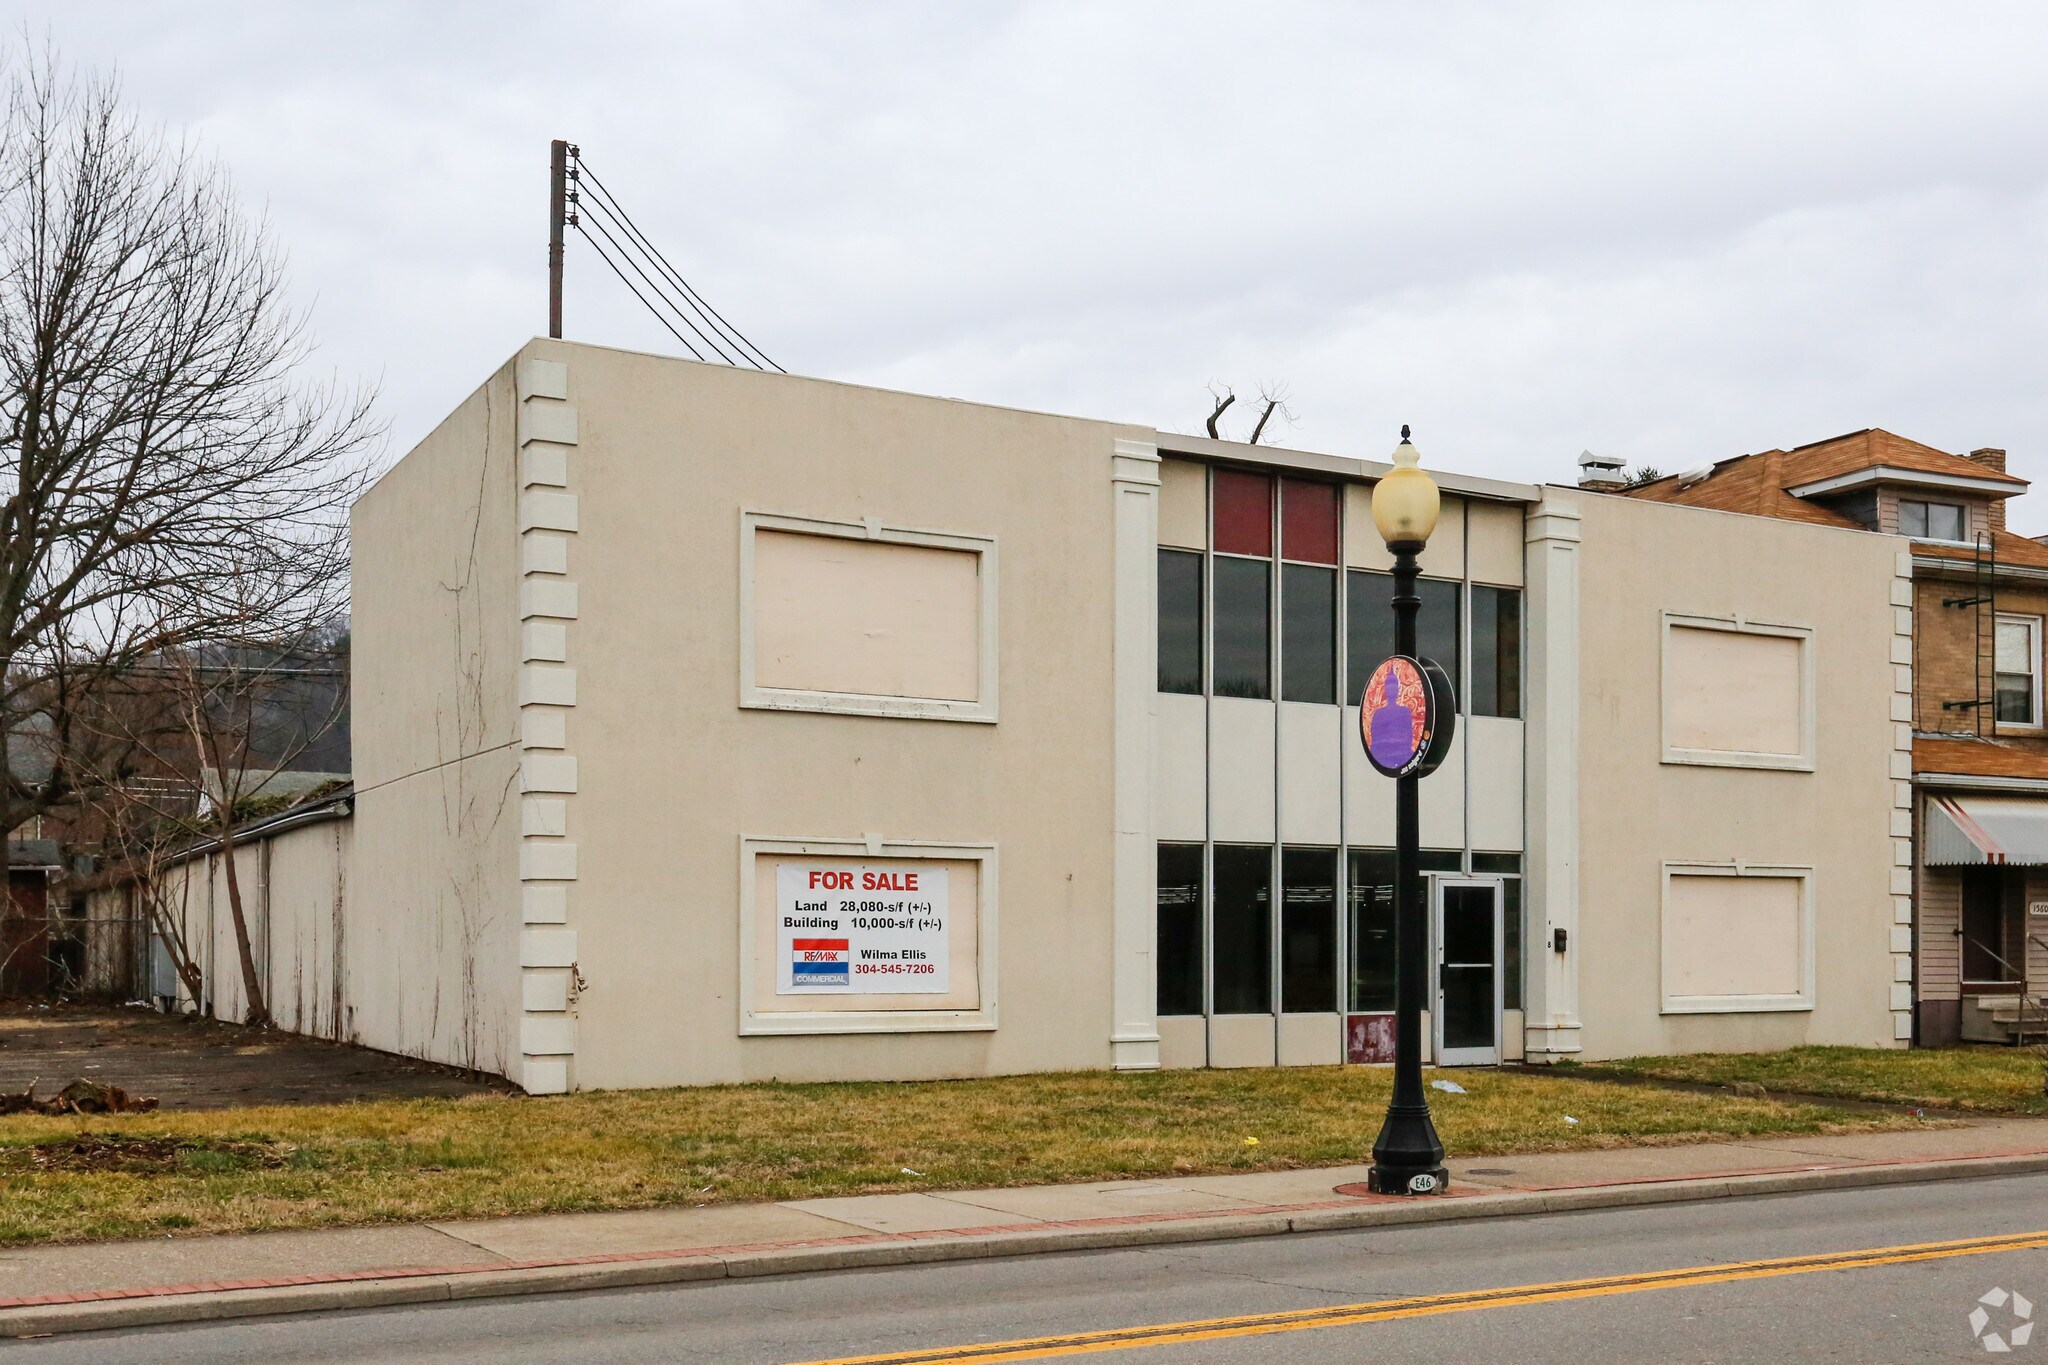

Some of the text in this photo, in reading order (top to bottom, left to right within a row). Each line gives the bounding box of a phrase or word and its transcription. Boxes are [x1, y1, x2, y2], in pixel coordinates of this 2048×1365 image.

[809, 871, 918, 891] FOR SALE
[795, 901, 931, 914] Land 28,080-s/f (+/-)
[784, 917, 942, 931] Building 10,000-s/f (+/-)
[804, 951, 838, 962] RE/MAX
[861, 950, 926, 959] Wilma Ellis
[855, 964, 934, 974] 304-545-7206
[796, 975, 846, 983] COMMERCIAL
[1416, 1177, 1431, 1188] E46
